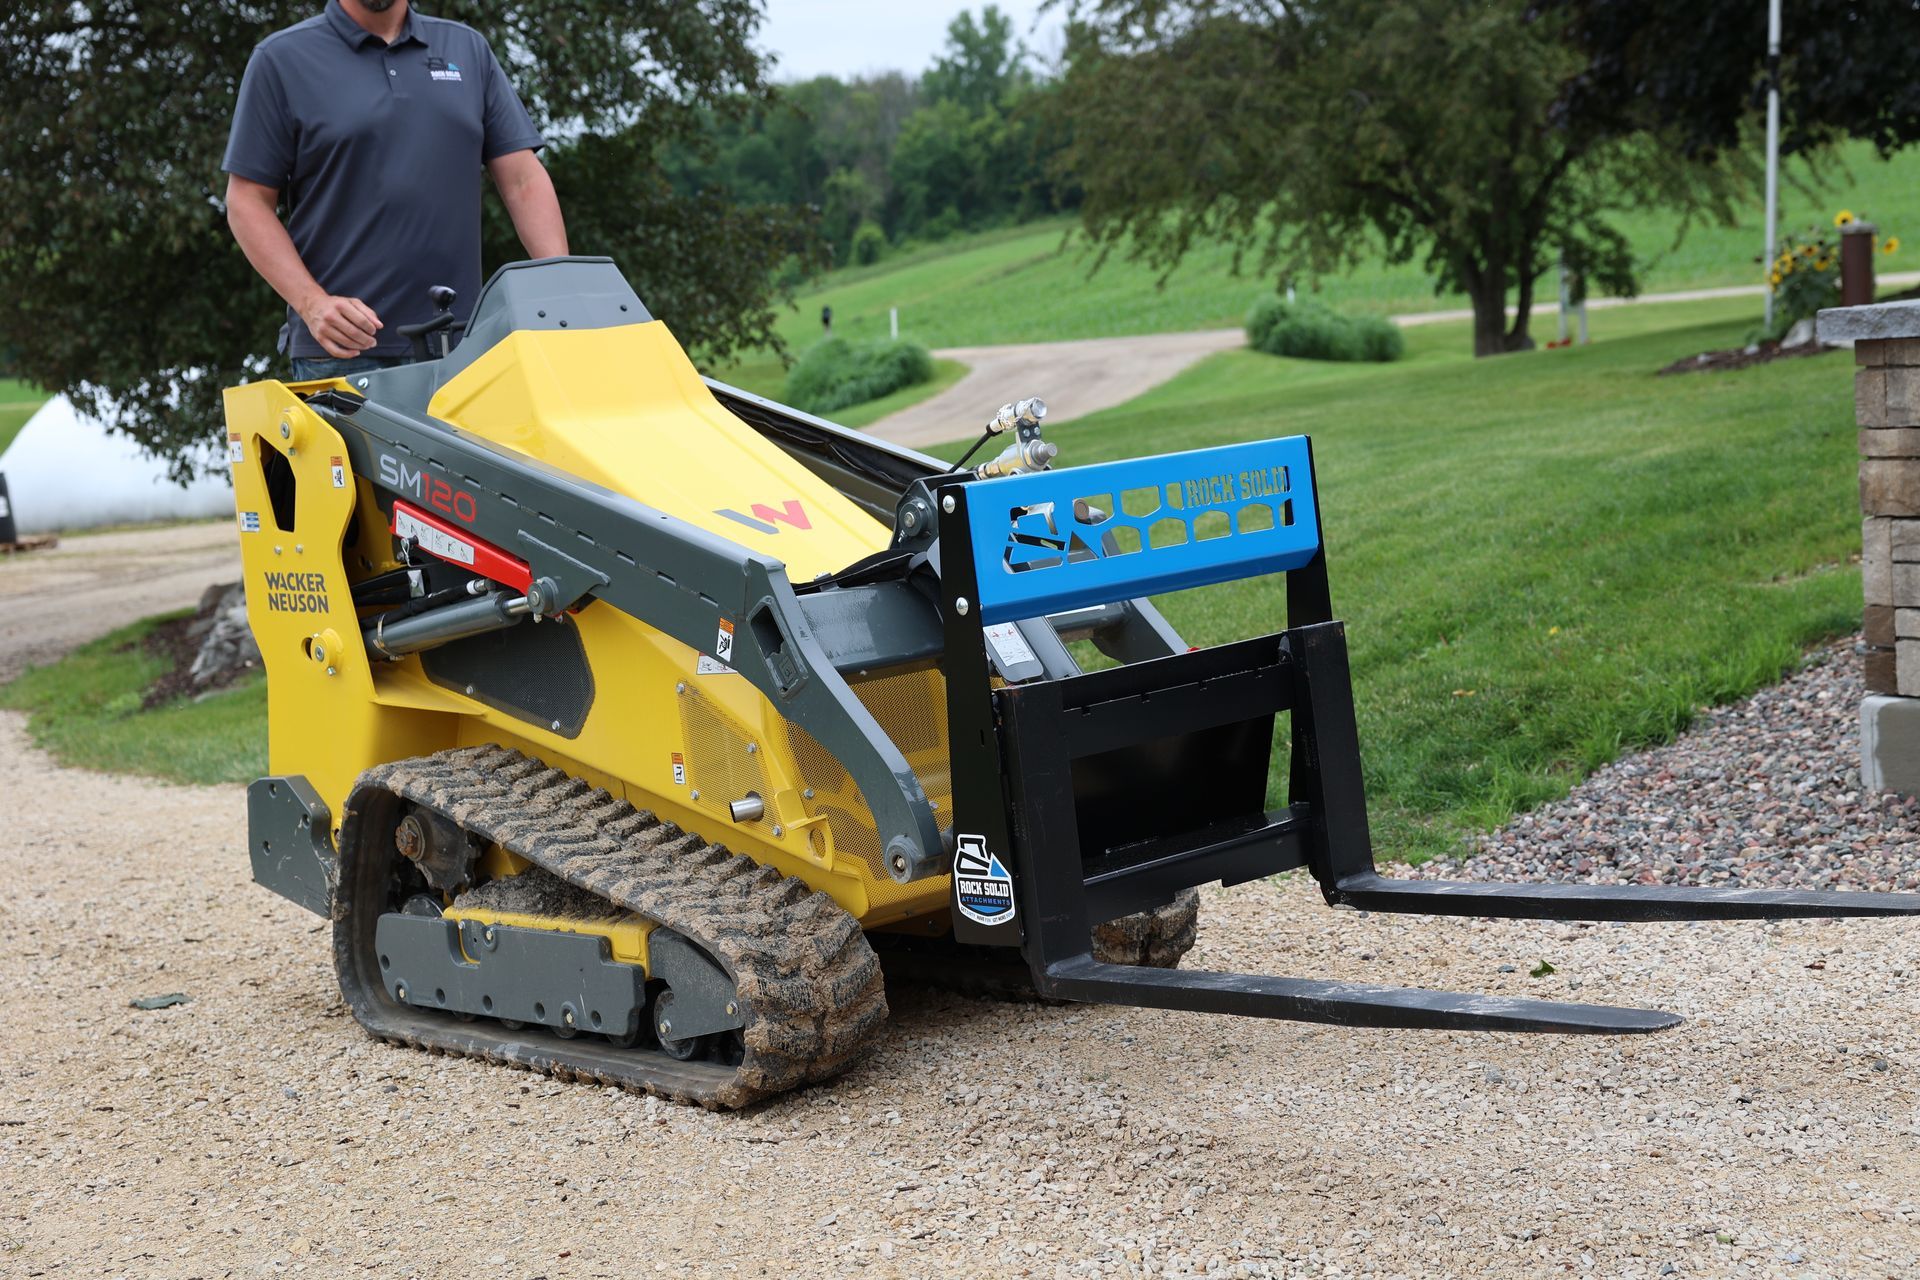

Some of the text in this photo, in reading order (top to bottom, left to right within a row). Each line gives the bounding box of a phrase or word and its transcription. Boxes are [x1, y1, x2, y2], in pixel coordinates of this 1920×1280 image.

[380, 454, 477, 522] SM120
[1185, 466, 1291, 508] ROCK SOLID
[264, 572, 327, 592] WACKER
[268, 593, 329, 614] NEUSON
[960, 881, 1009, 897] ROCK SOLID
[961, 896, 1011, 905] ATTACHMENTS
